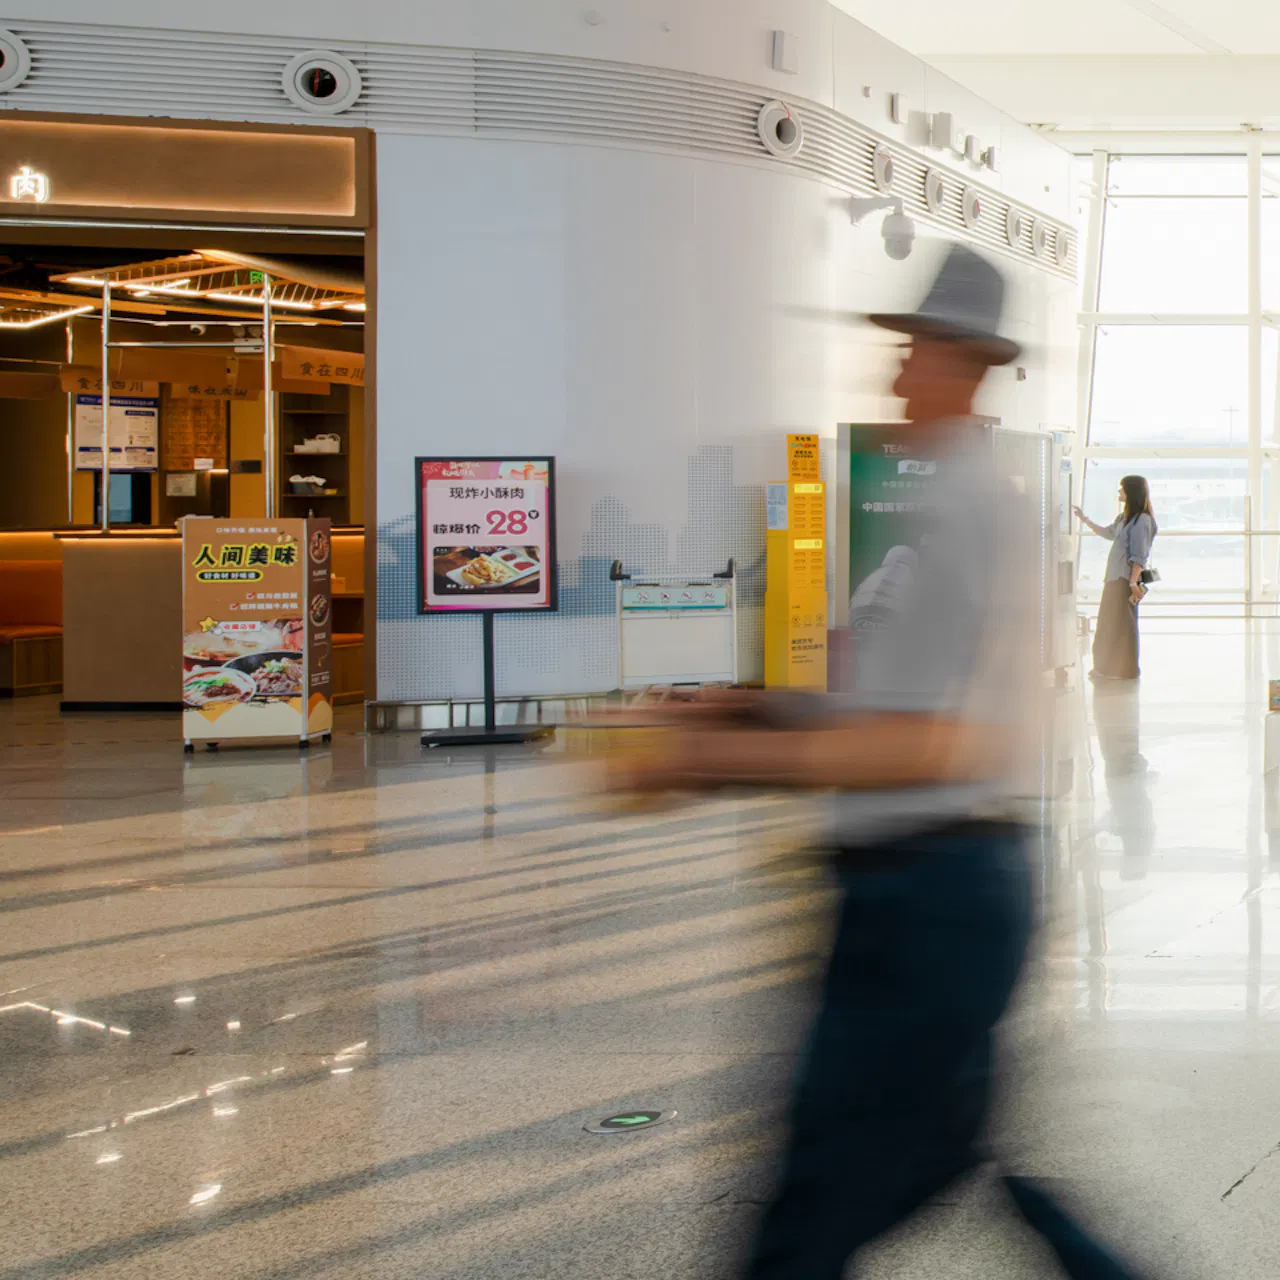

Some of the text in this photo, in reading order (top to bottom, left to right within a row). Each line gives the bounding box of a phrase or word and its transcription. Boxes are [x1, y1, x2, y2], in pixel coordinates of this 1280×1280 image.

[10, 166, 49, 202] 肉
[449, 487, 524, 499] 现炸小酥肉
[485, 509, 528, 535] 28
[193, 544, 297, 567] 人间美味
